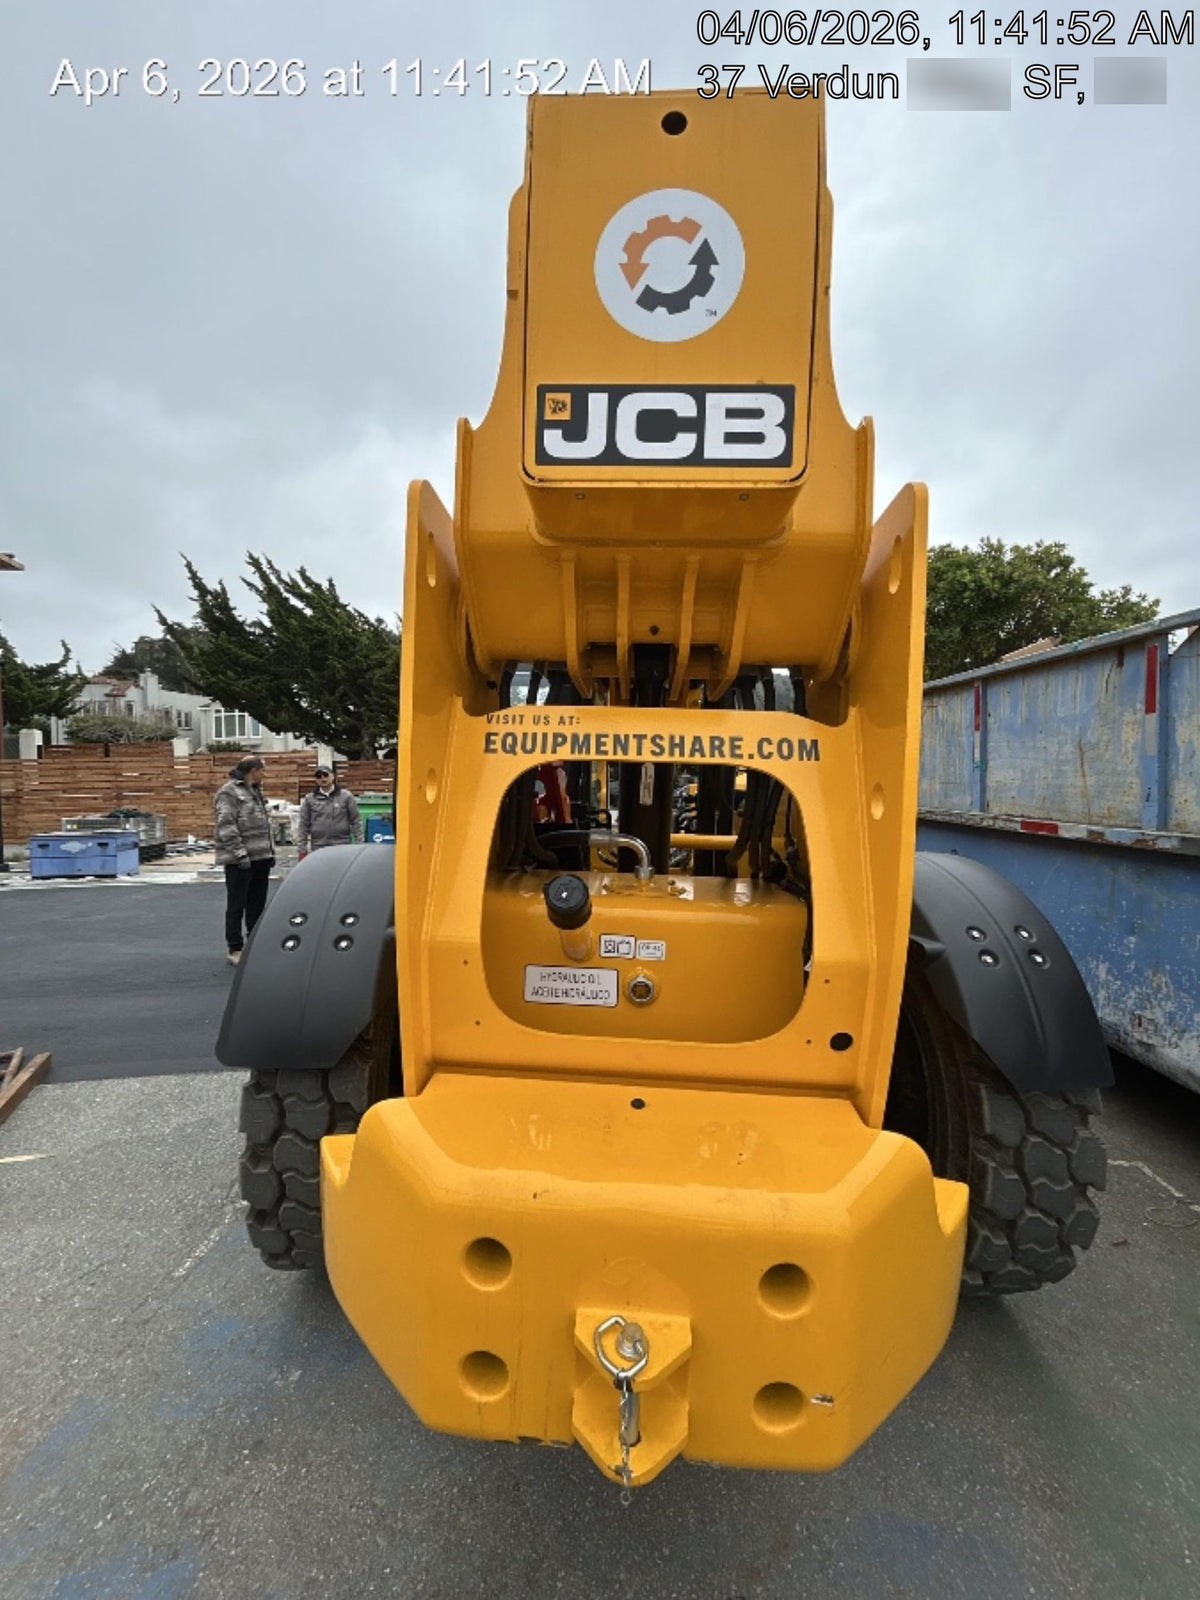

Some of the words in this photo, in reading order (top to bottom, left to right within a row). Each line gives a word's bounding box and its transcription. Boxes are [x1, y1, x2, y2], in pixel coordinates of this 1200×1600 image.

[543, 392, 786, 459] JCB
[486, 714, 524, 725] VISIT
[532, 715, 550, 726] US
[557, 716, 581, 726] AT:
[483, 731, 821, 762] EQUIPMENTSHARE.COM
